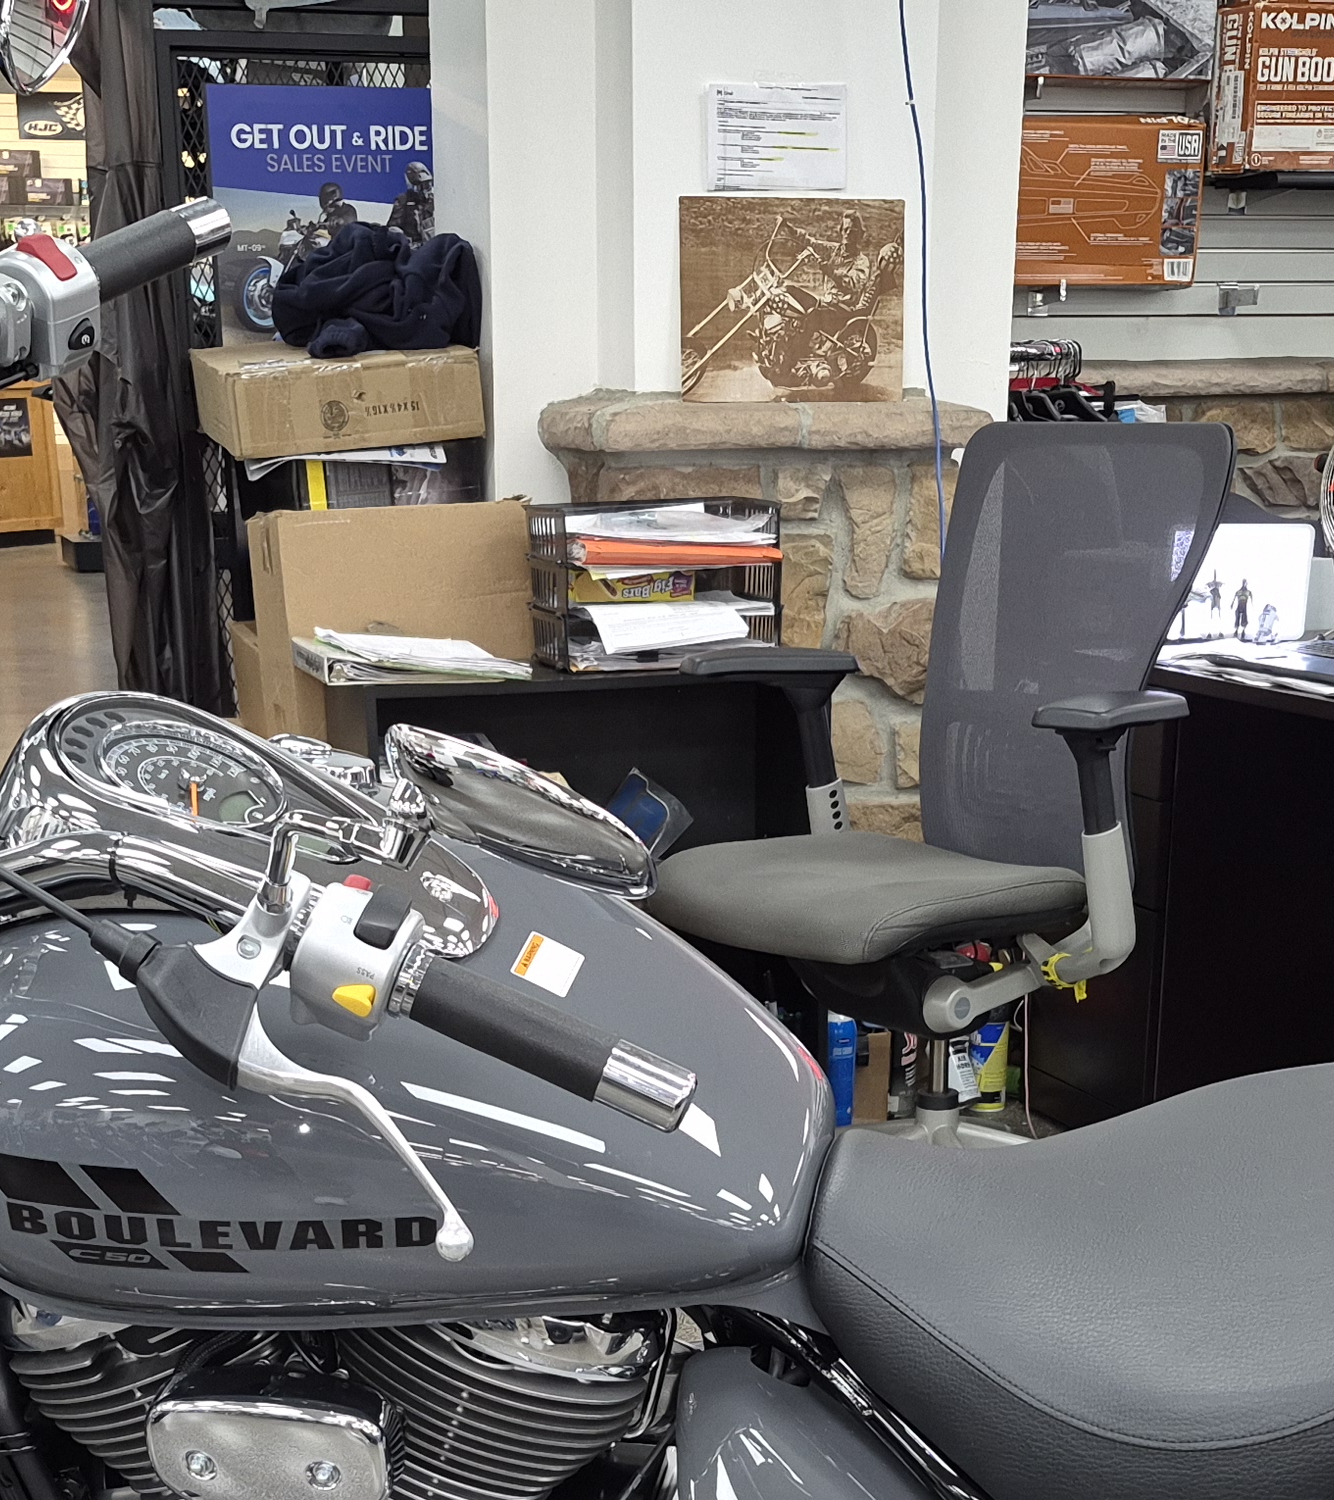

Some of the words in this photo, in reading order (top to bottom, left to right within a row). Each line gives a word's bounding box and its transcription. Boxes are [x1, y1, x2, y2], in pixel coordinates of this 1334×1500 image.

[1224, 14, 1240, 61] GUN
[1244, 12, 1255, 69] KOLPIN
[1257, 56, 1296, 82] GUN
[28, 122, 59, 132] HJC
[230, 123, 284, 149] GET
[289, 124, 347, 150] OUT
[352, 132, 365, 146] &
[369, 125, 429, 151] RIDE
[1178, 135, 1199, 156] USA
[267, 154, 326, 173] SALES
[332, 154, 393, 173] EVENT
[622, 584, 652, 598] Bars
[653, 576, 675, 594] Fig
[128, 745, 141, 756] 70
[356, 966, 376, 980] PASS
[5, 1200, 438, 1251] BOULEVARD
